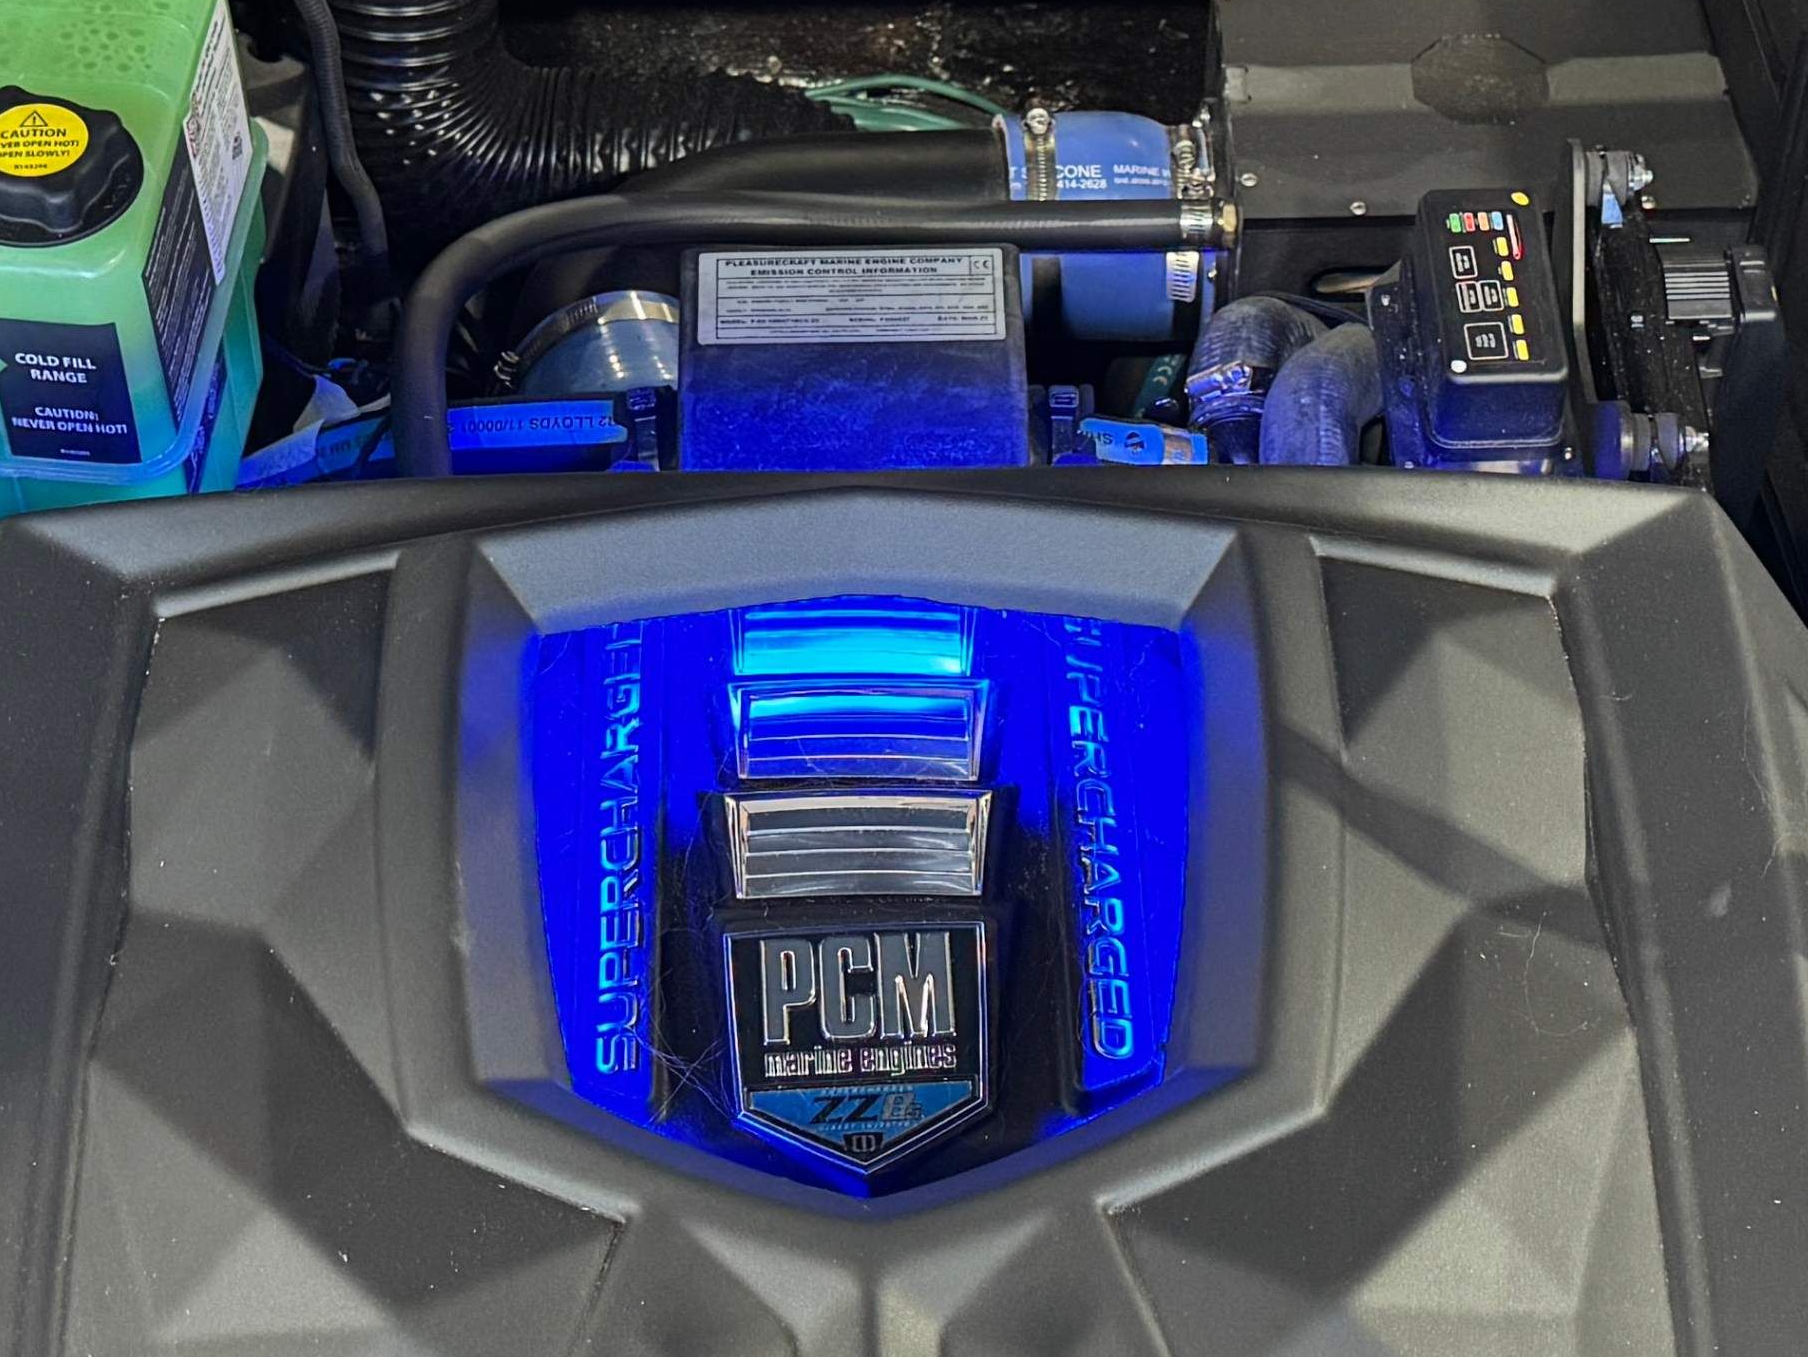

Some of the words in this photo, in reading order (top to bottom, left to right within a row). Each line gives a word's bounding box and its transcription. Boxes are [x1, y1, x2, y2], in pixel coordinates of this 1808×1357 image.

[0, 128, 67, 139] CAUTION
[22, 140, 52, 148] OPEN
[1113, 164, 1160, 176] MARINE
[865, 257, 907, 265] ENGINE
[751, 268, 804, 276] EMISSION
[861, 267, 938, 275] INFORMATION
[14, 353, 60, 367] COLD
[62, 357, 97, 370] FILL
[30, 369, 88, 384] RANGE
[11, 417, 55, 430] NEVER
[57, 421, 93, 433] OPEN
[529, 416, 595, 431] LLOYDS
[760, 931, 958, 1045] PCM
[764, 1046, 853, 1077] marine
[860, 1041, 957, 1077] engines
